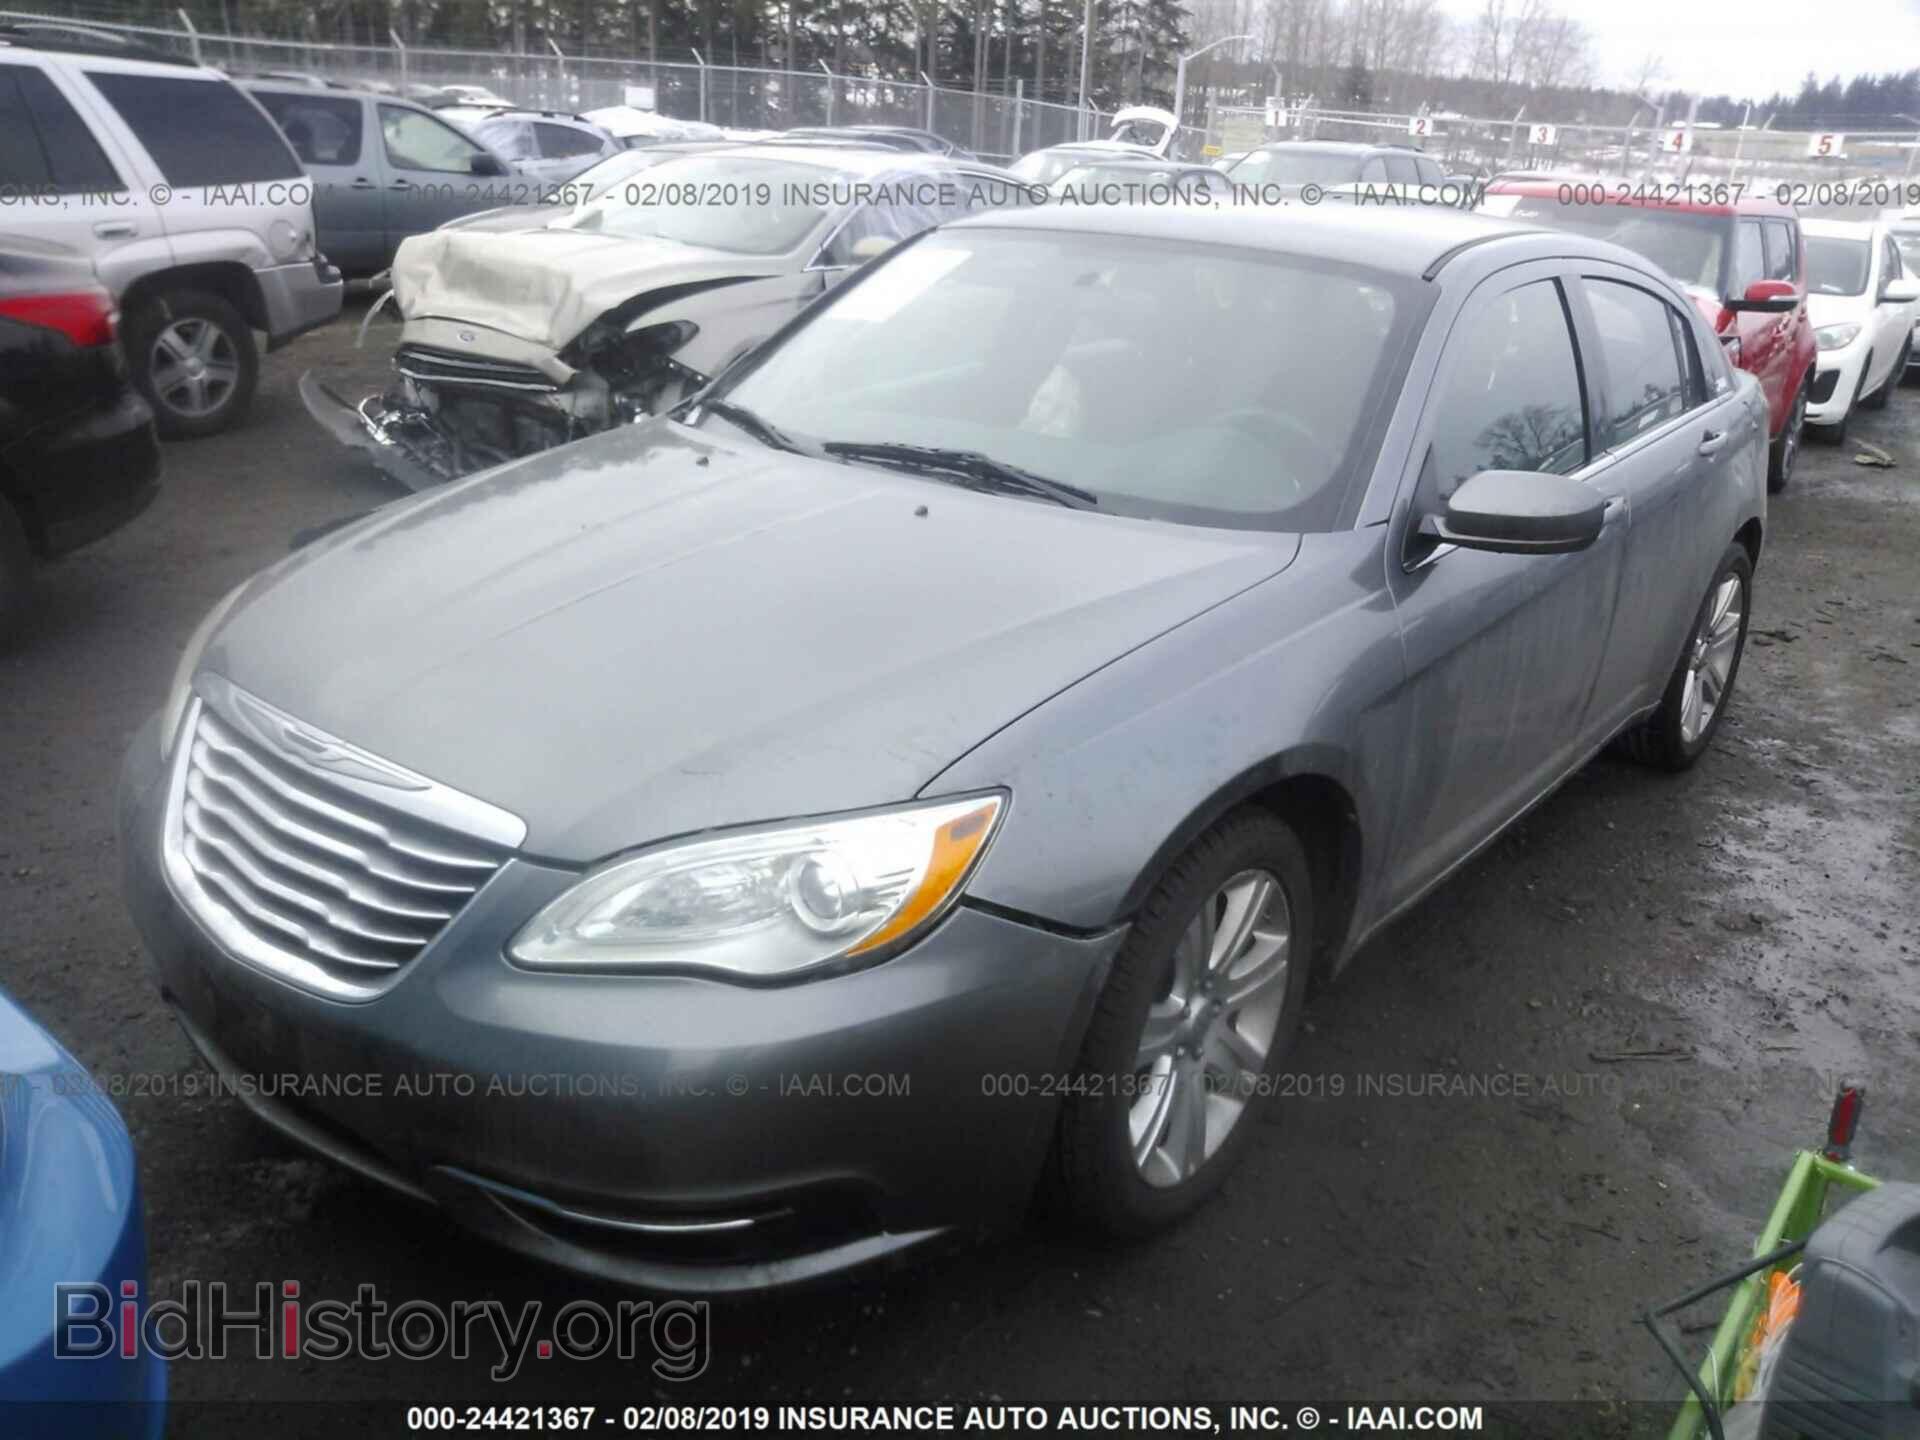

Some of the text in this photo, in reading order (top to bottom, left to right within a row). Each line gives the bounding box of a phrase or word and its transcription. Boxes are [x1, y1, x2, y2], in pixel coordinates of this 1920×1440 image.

[1416, 119, 1426, 135] 2
[1538, 126, 1549, 144] 3
[1672, 132, 1684, 152] 4
[1818, 135, 1833, 155] 5
